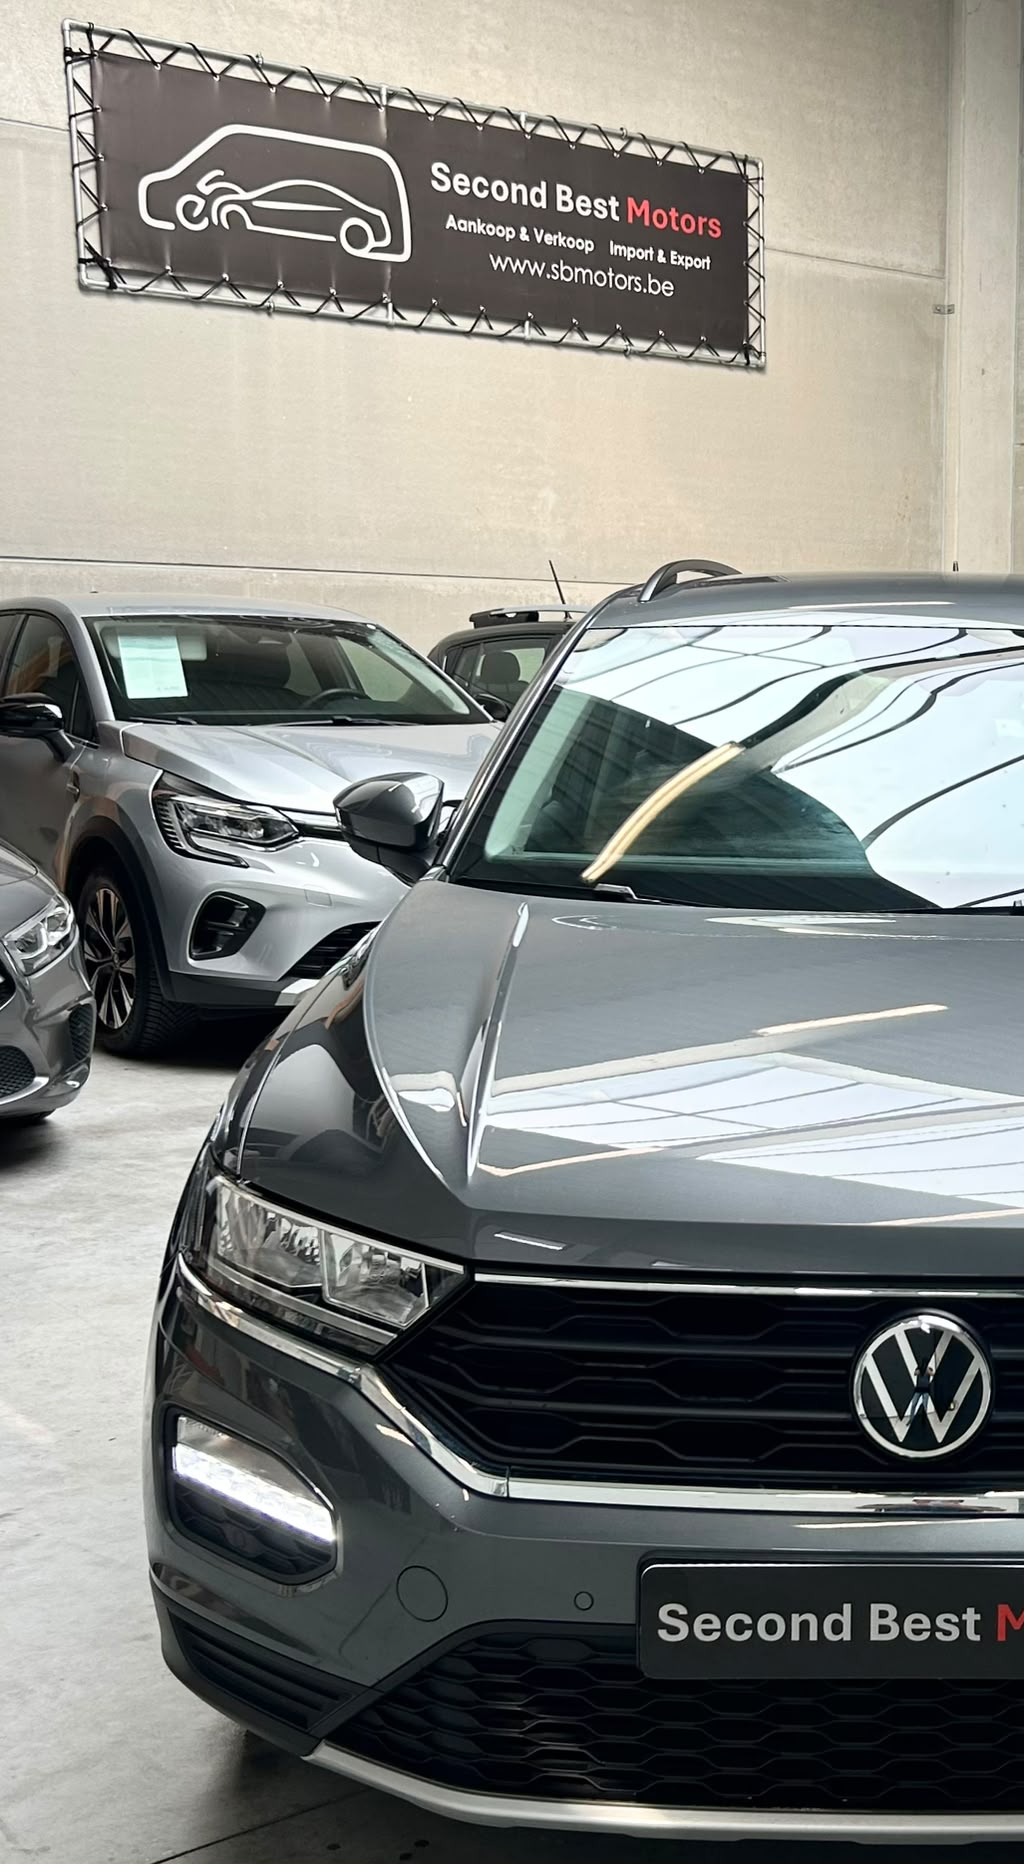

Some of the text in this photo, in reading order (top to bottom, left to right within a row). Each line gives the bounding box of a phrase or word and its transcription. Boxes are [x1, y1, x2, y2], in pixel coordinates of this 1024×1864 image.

[430, 161, 722, 238] Second Best Motors
[445, 214, 711, 271] Aankoop & Verkoop Import & Export
[489, 253, 675, 297] www.sbmotors.be
[657, 1603, 852, 1642] Second
[868, 1604, 981, 1642] Best
